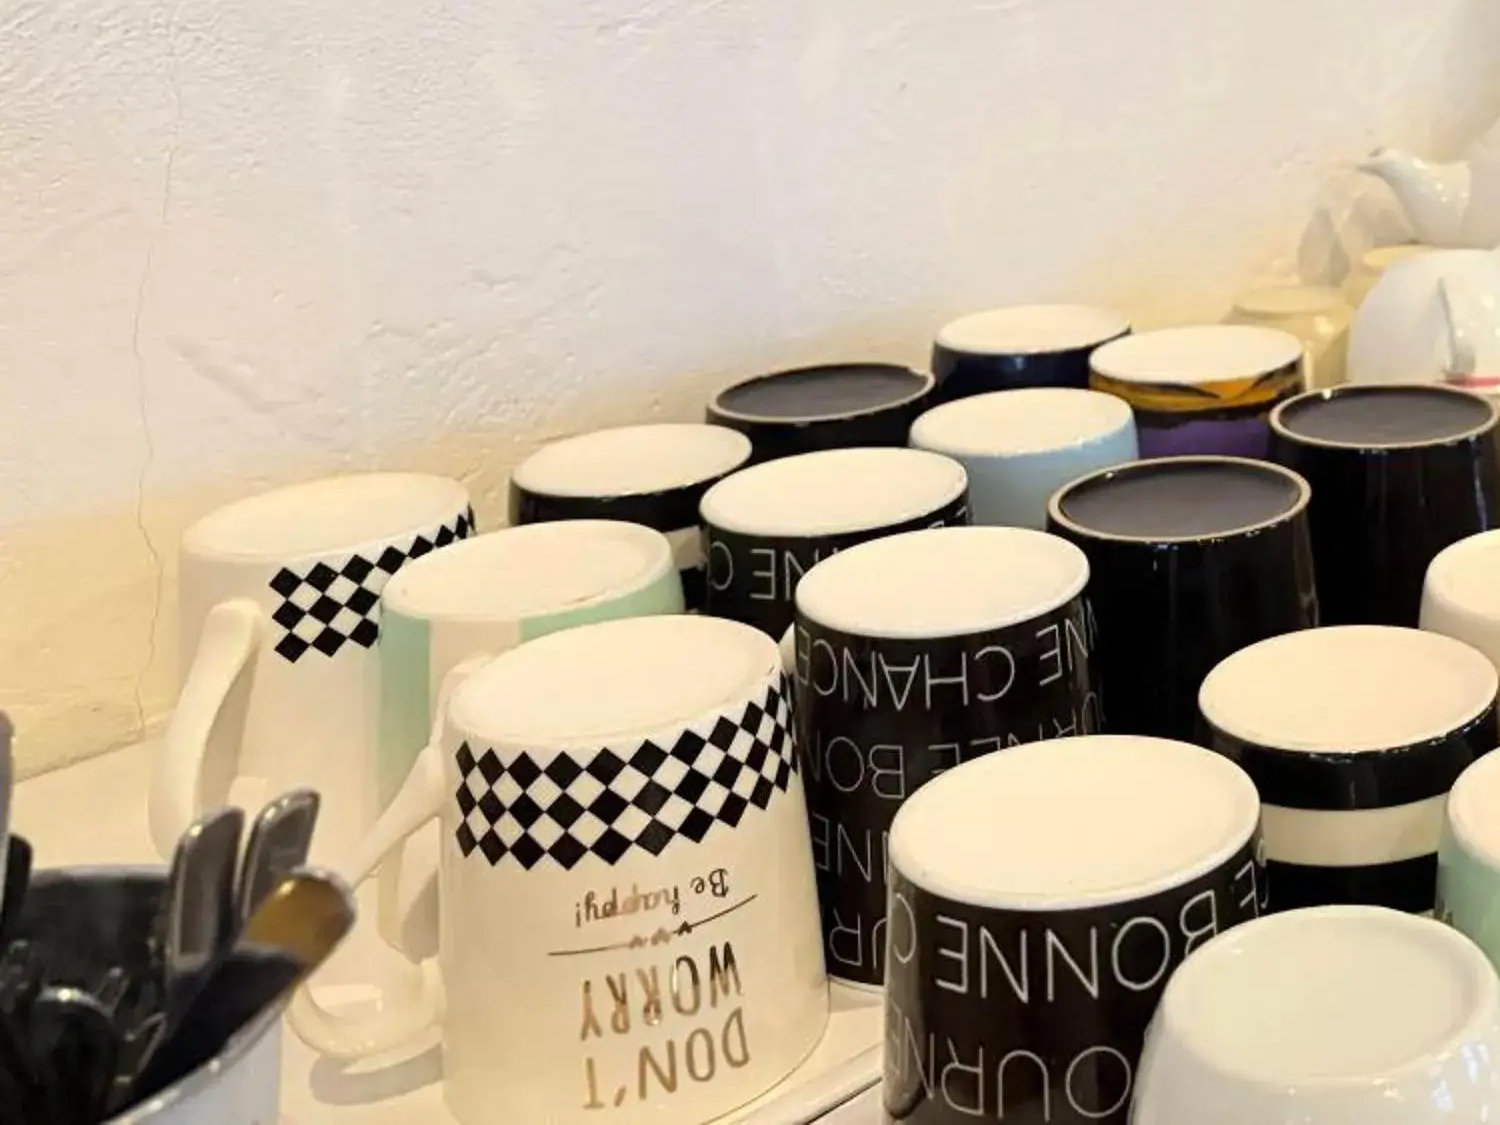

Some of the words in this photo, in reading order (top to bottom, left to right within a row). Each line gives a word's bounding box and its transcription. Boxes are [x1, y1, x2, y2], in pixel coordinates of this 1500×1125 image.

[796, 624, 1016, 712] CHANCE
[575, 883, 680, 928] happy!
[690, 867, 730, 898] Be
[580, 941, 744, 1042] WORRY
[935, 889, 1219, 1004] BONNE
[582, 1006, 751, 1110] DON'T
